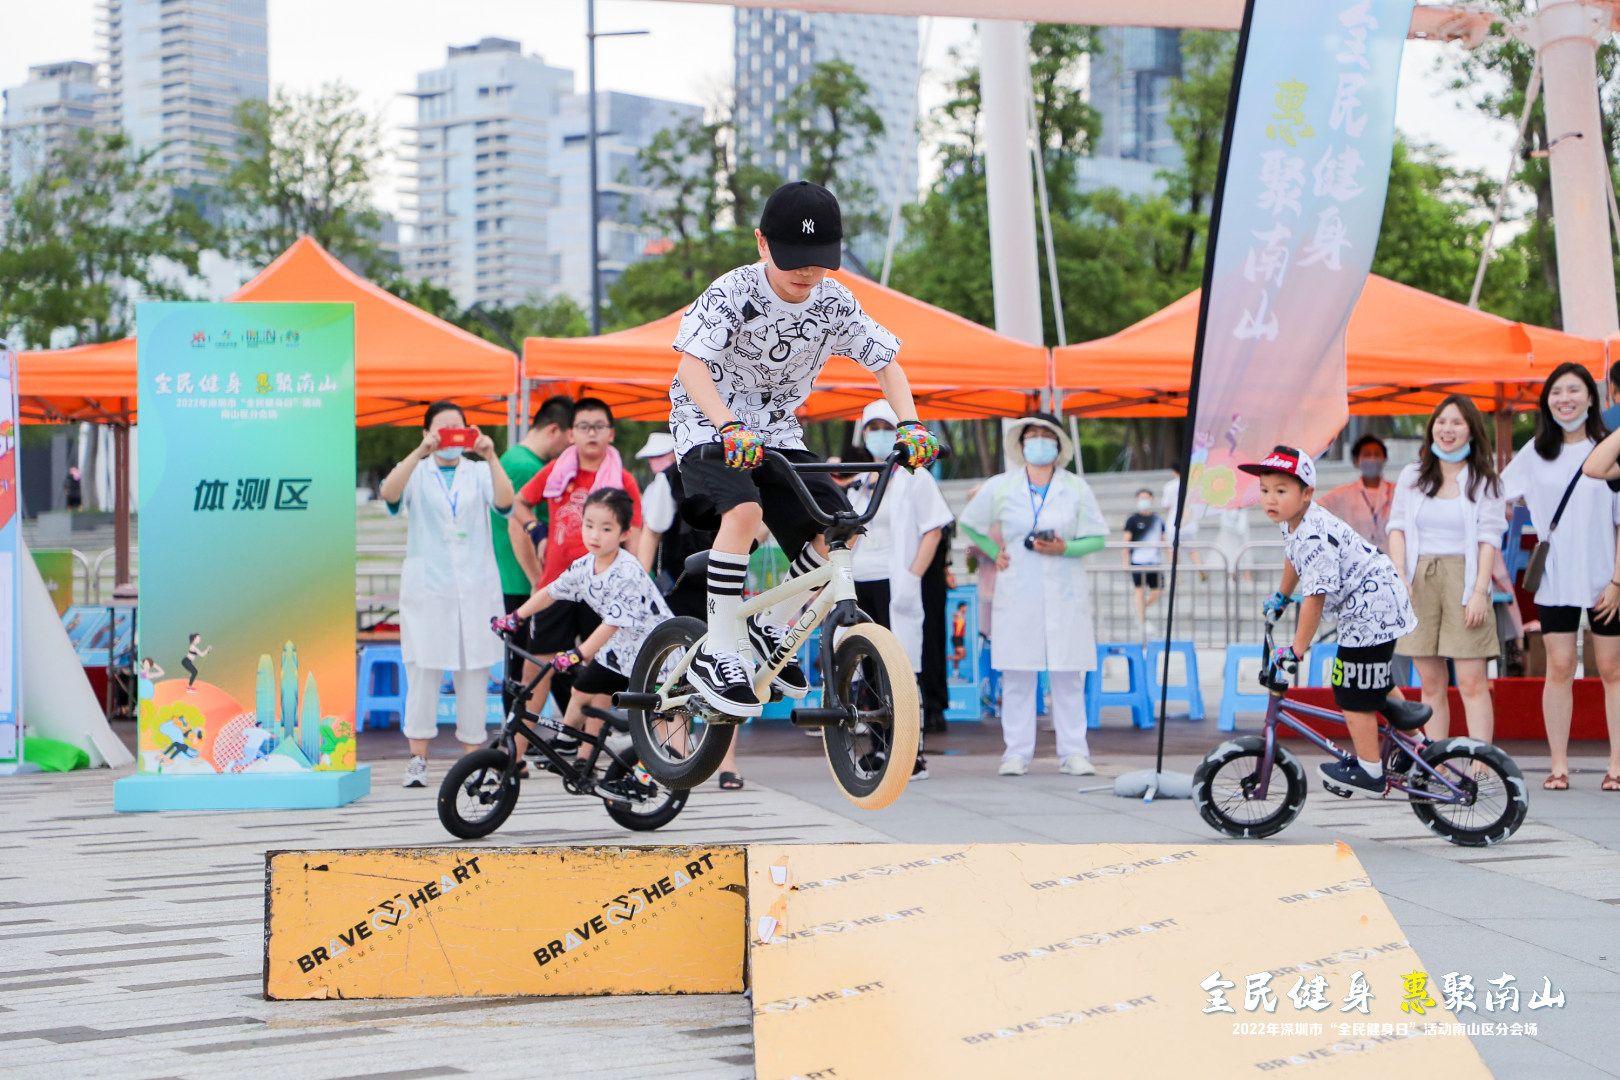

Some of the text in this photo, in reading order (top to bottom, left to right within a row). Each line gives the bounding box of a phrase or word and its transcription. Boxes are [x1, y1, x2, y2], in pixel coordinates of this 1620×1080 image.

[802, 218, 815, 234] NY
[193, 477, 313, 511] 体测区
[899, 852, 966, 871] HEART
[1030, 850, 1198, 890] BRAVE HEART
[533, 853, 714, 967] BRAVE HEART
[1278, 885, 1349, 904] BRAVE
[297, 857, 480, 974] BRAVE HEART
[308, 944, 375, 988] EXTREME
[455, 878, 492, 903] PARK
[543, 874, 725, 981] EXTREME SPORTS PARK
[854, 906, 927, 926] HEART
[999, 918, 1178, 962] BRAVE HEART
[806, 981, 884, 1003] HEART
[961, 995, 1157, 1046] BRAVE HEART
[1255, 1048, 1335, 1072] BRAVE
